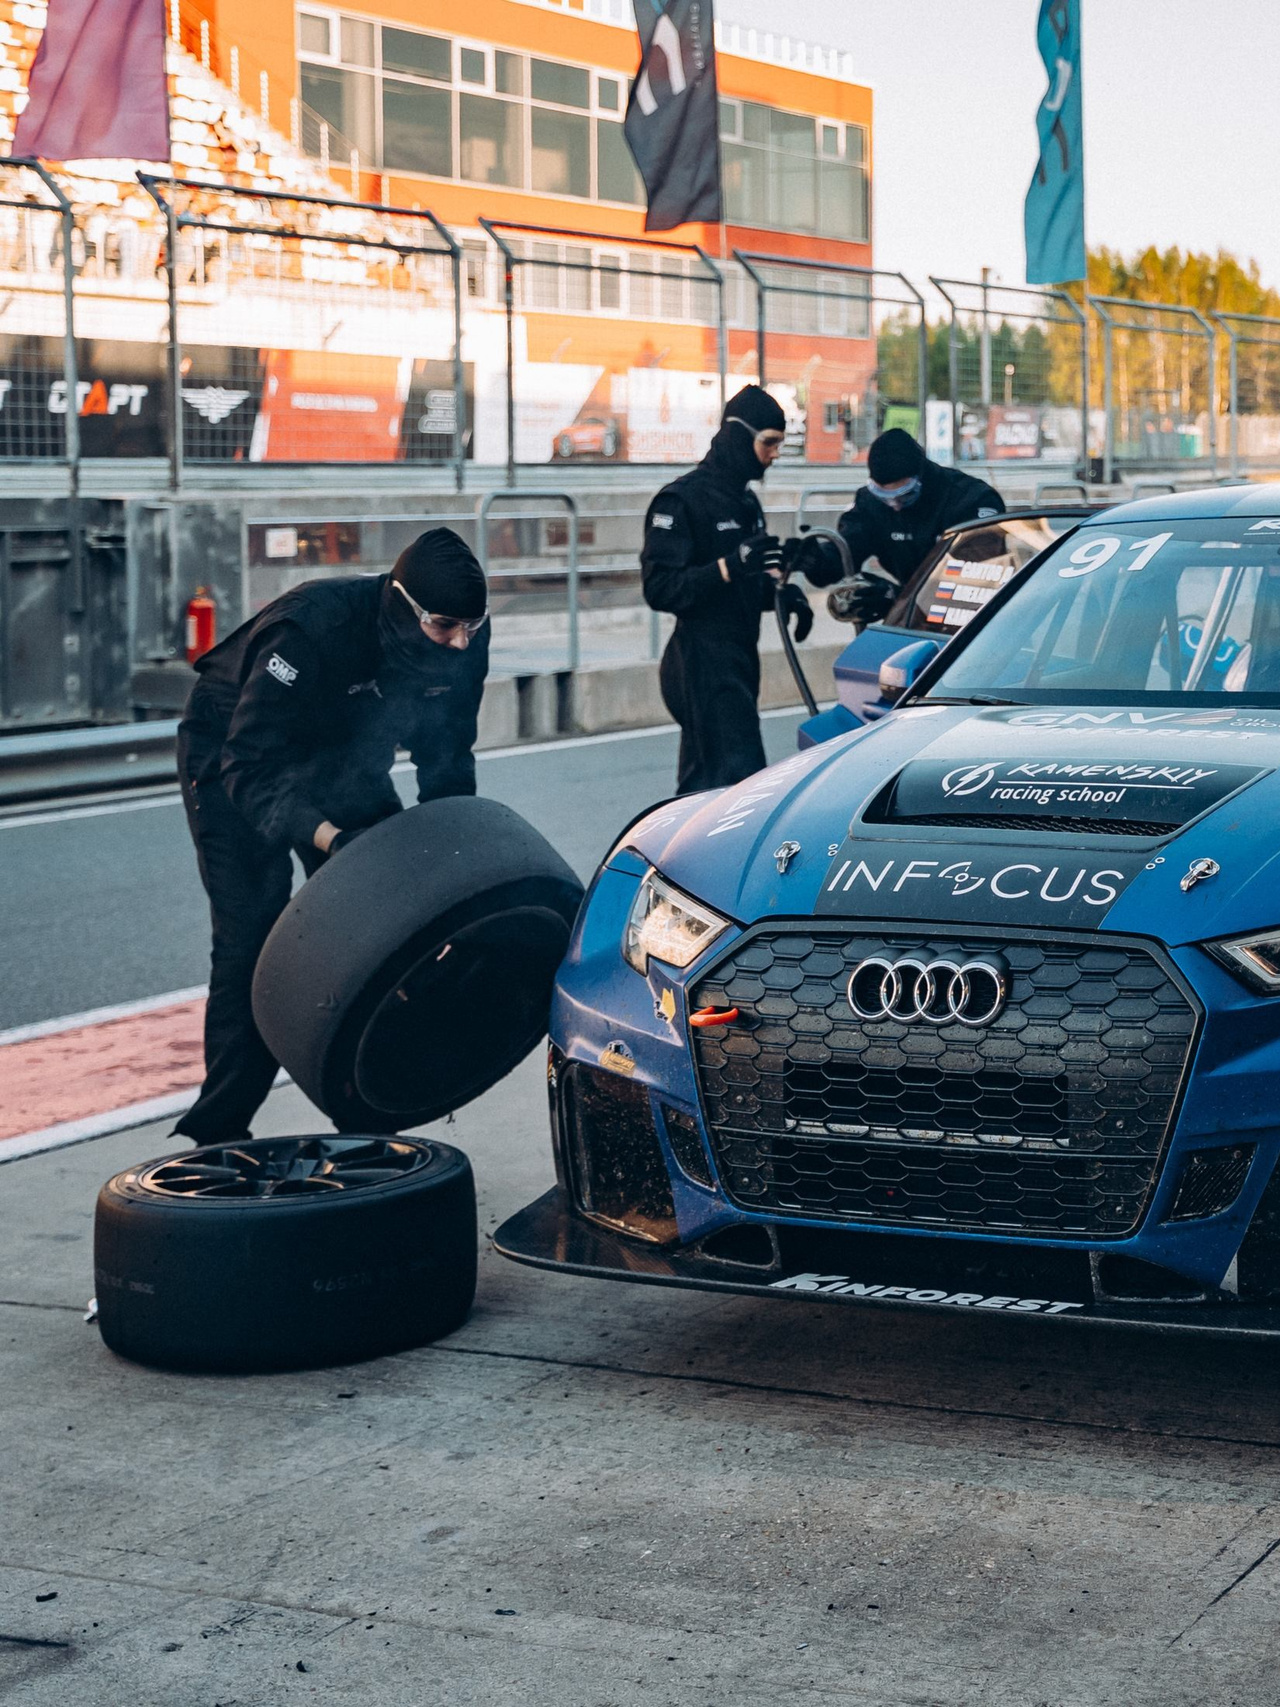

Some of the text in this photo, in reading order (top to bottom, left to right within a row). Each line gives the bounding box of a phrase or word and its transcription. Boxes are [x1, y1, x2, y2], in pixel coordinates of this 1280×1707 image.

[48, 379, 149, 417] СТАРТ
[1058, 532, 1174, 579] 91
[268, 657, 297, 682] OMP
[1007, 712, 1185, 726] GNV
[1006, 762, 1218, 785] KAMENSKIY
[990, 785, 1127, 805] racing school
[827, 860, 1125, 906] INFOCUS
[767, 1272, 1085, 1314] KINFOREST
